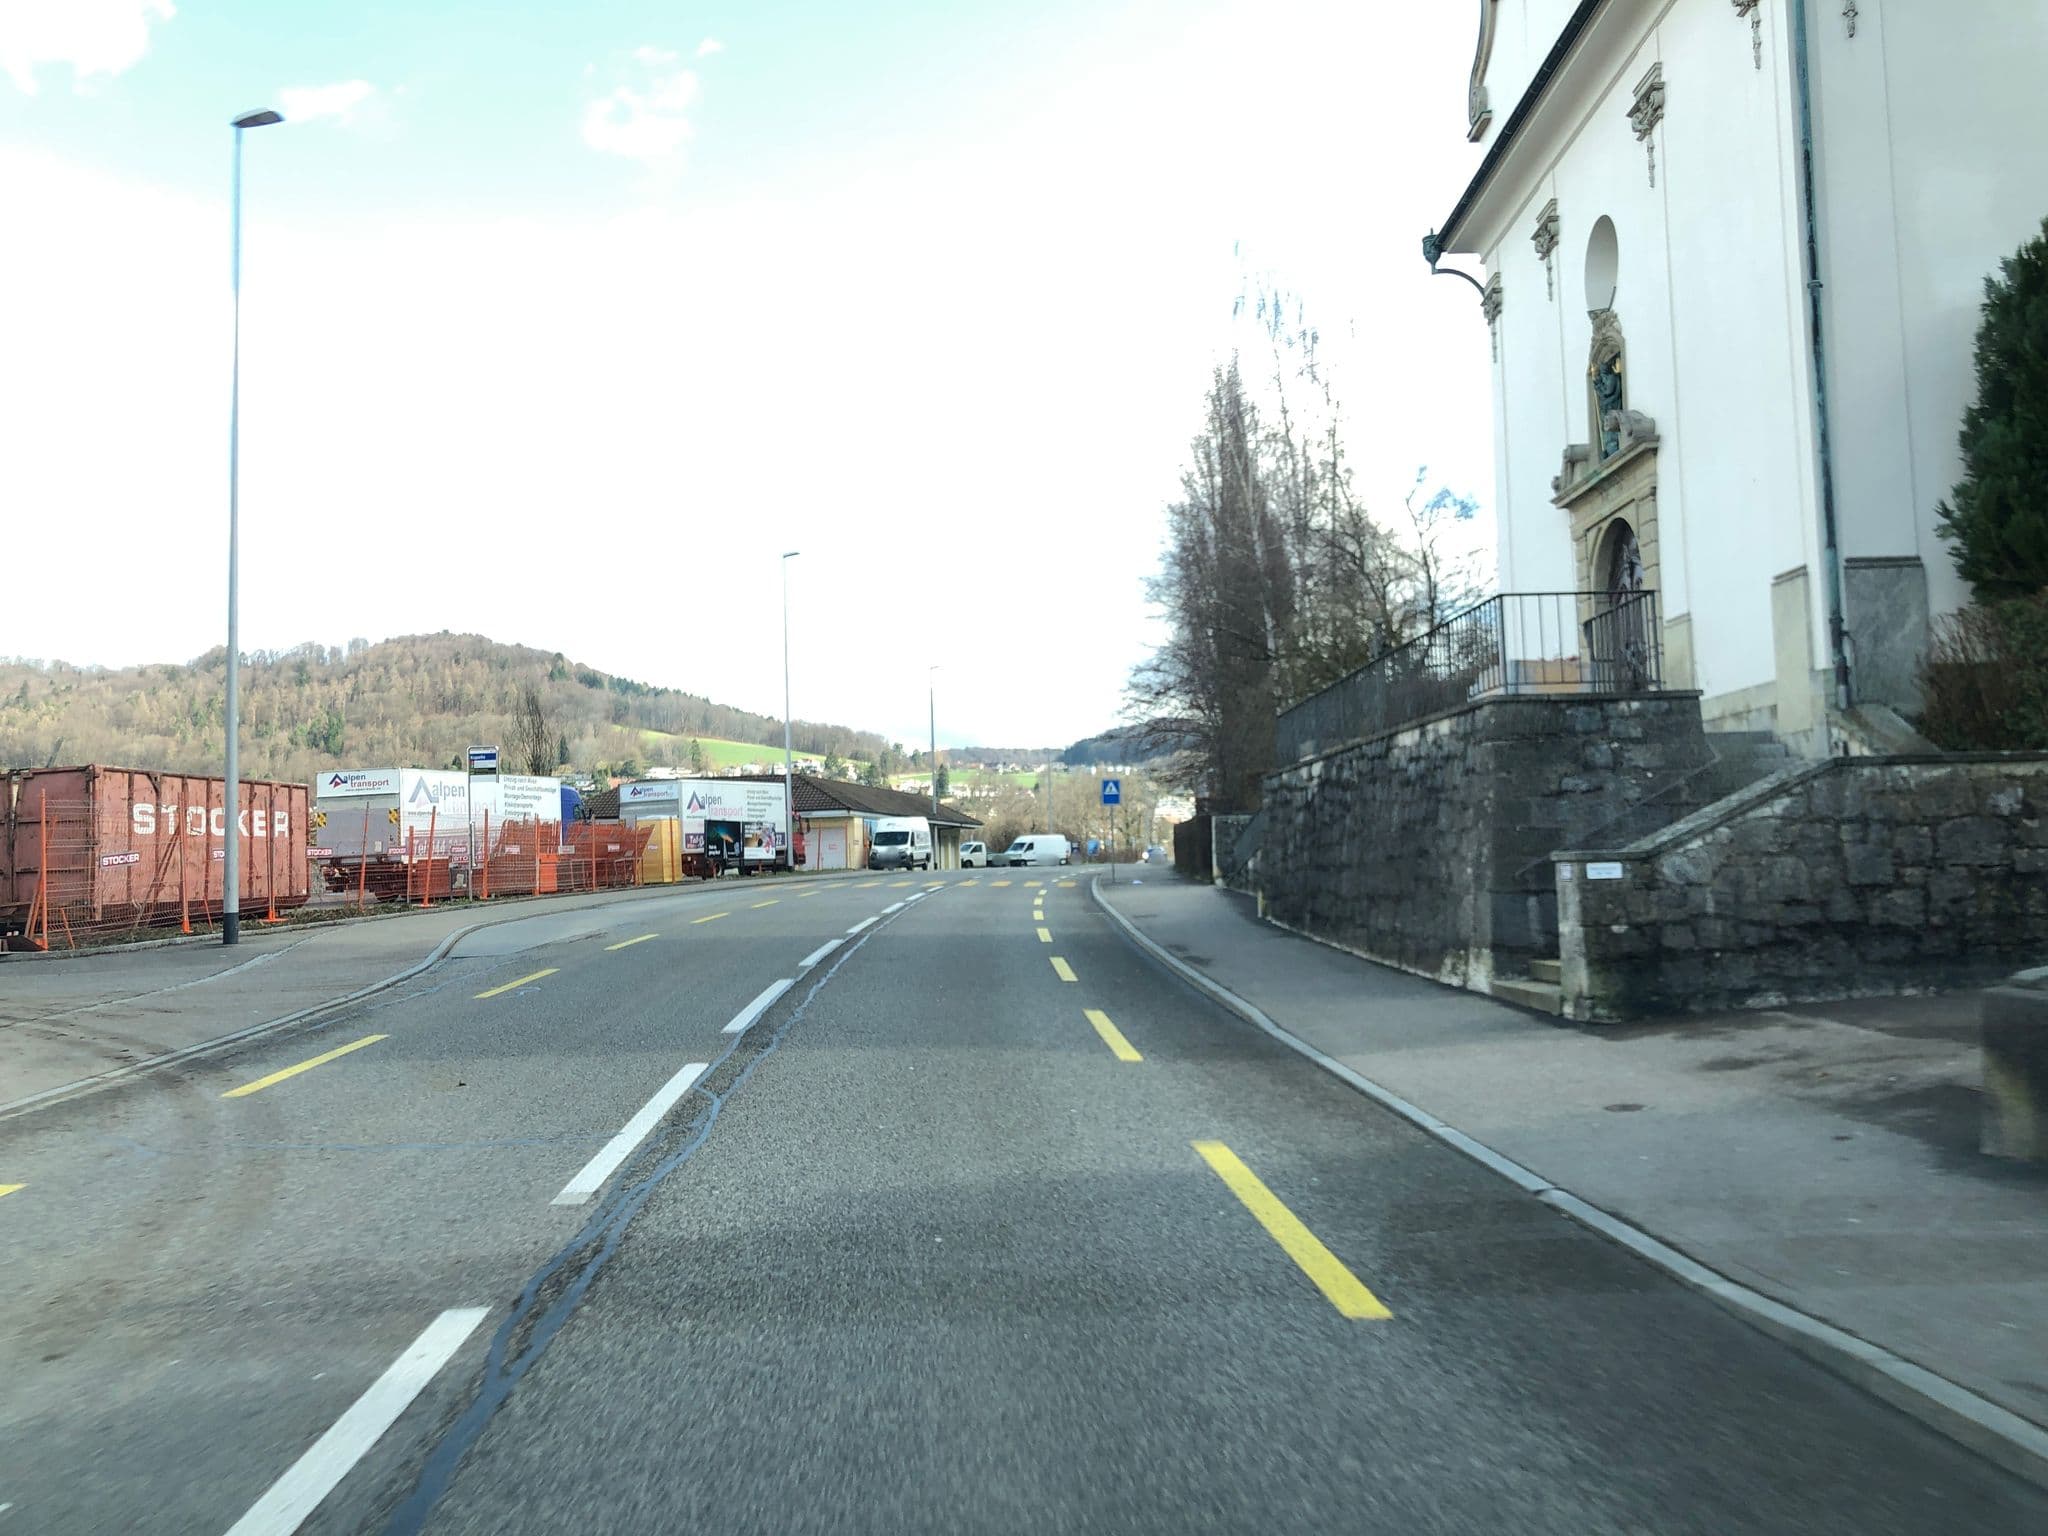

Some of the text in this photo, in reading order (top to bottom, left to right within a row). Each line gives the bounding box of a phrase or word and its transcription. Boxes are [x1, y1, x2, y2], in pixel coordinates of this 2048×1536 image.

[343, 774, 366, 782] alpen
[350, 779, 389, 788] transport
[431, 780, 465, 800] alpen
[701, 793, 722, 809] alpen
[708, 807, 743, 817] transport
[133, 804, 289, 838] STOCKER
[102, 853, 140, 866] STOCKER
